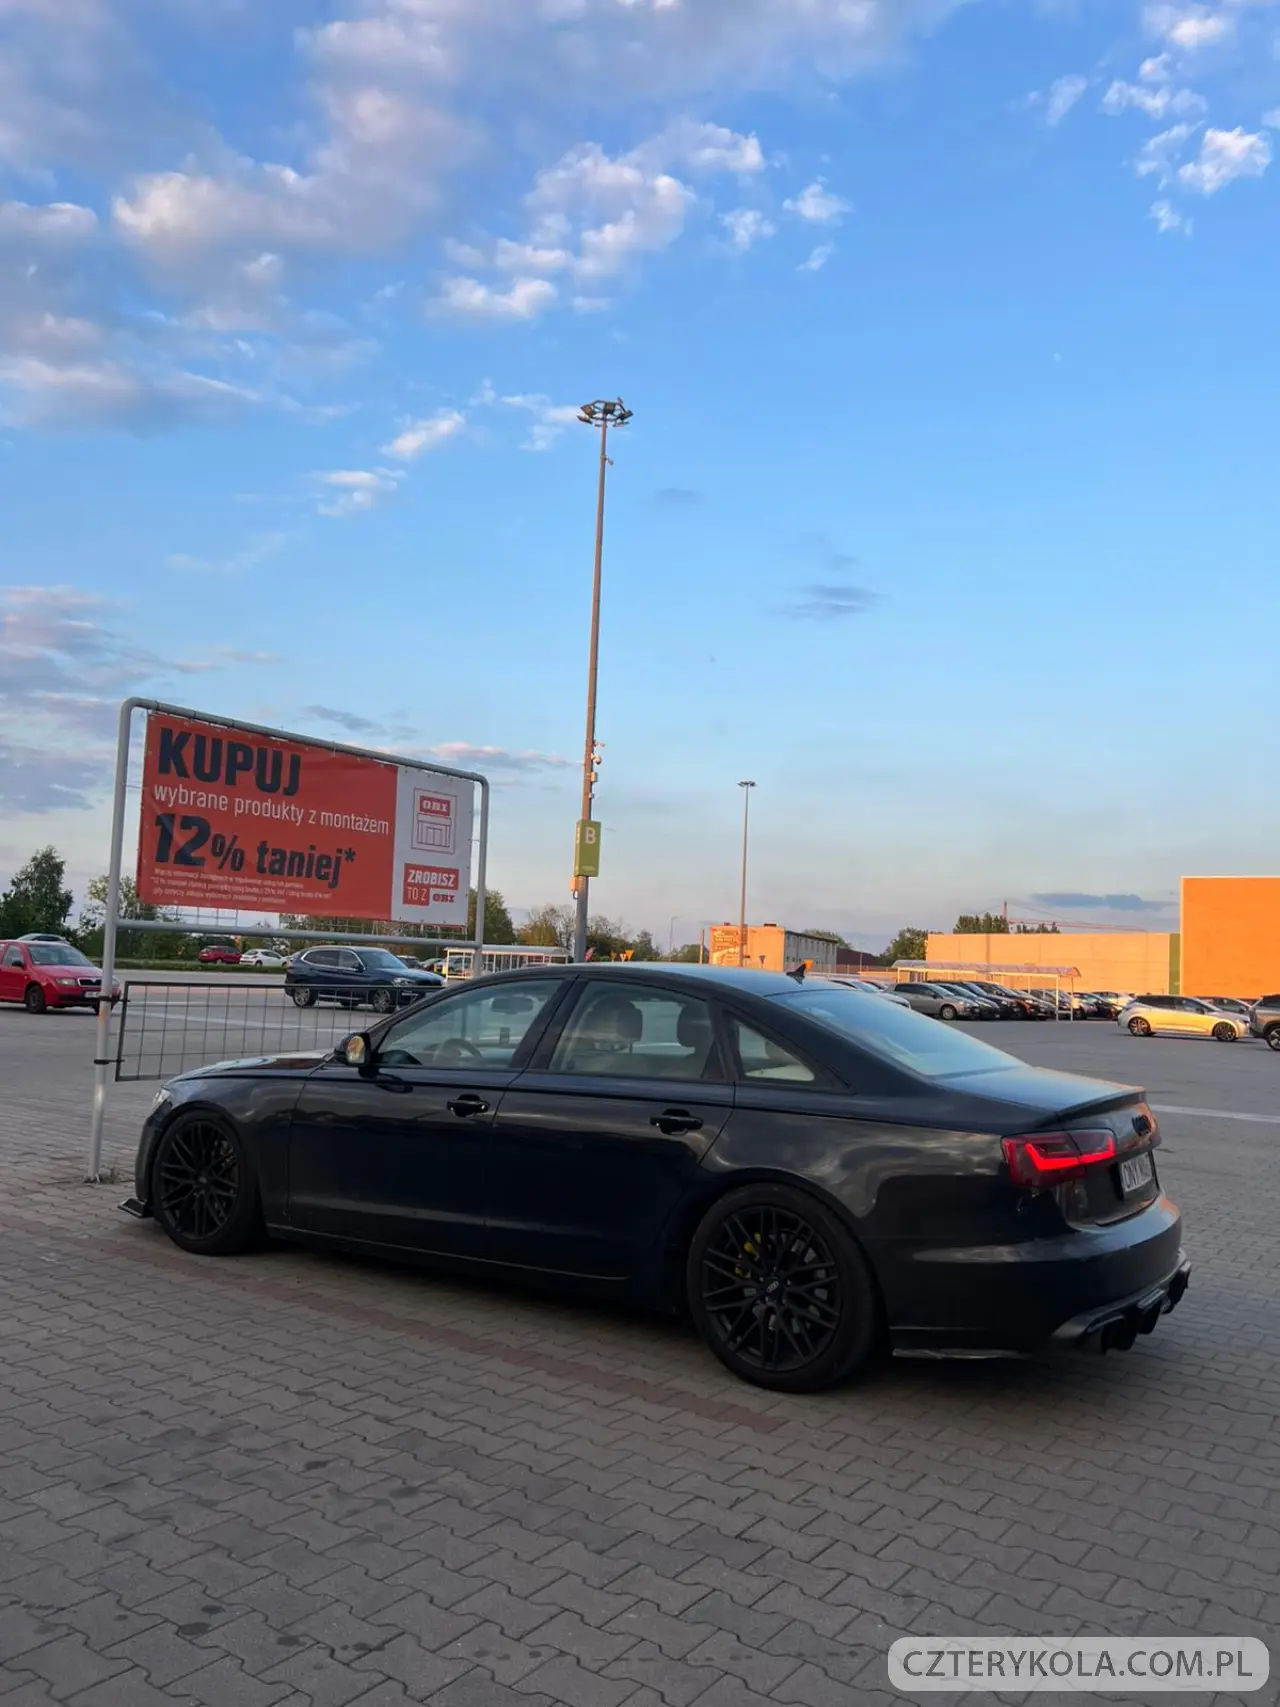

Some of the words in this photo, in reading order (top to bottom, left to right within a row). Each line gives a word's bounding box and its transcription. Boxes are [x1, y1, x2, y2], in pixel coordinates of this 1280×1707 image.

[159, 728, 301, 796] KUPUJ
[154, 783, 228, 811] wybrane
[234, 796, 304, 825] produkty
[308, 809, 317, 825] z
[320, 811, 389, 836] montażem
[422, 798, 448, 813] OBI
[154, 813, 245, 873] 12%
[585, 826, 597, 844] B
[407, 869, 456, 888] ZROBISZ
[408, 887, 419, 900] TO
[421, 888, 428, 902] Z
[433, 893, 455, 904] OBI
